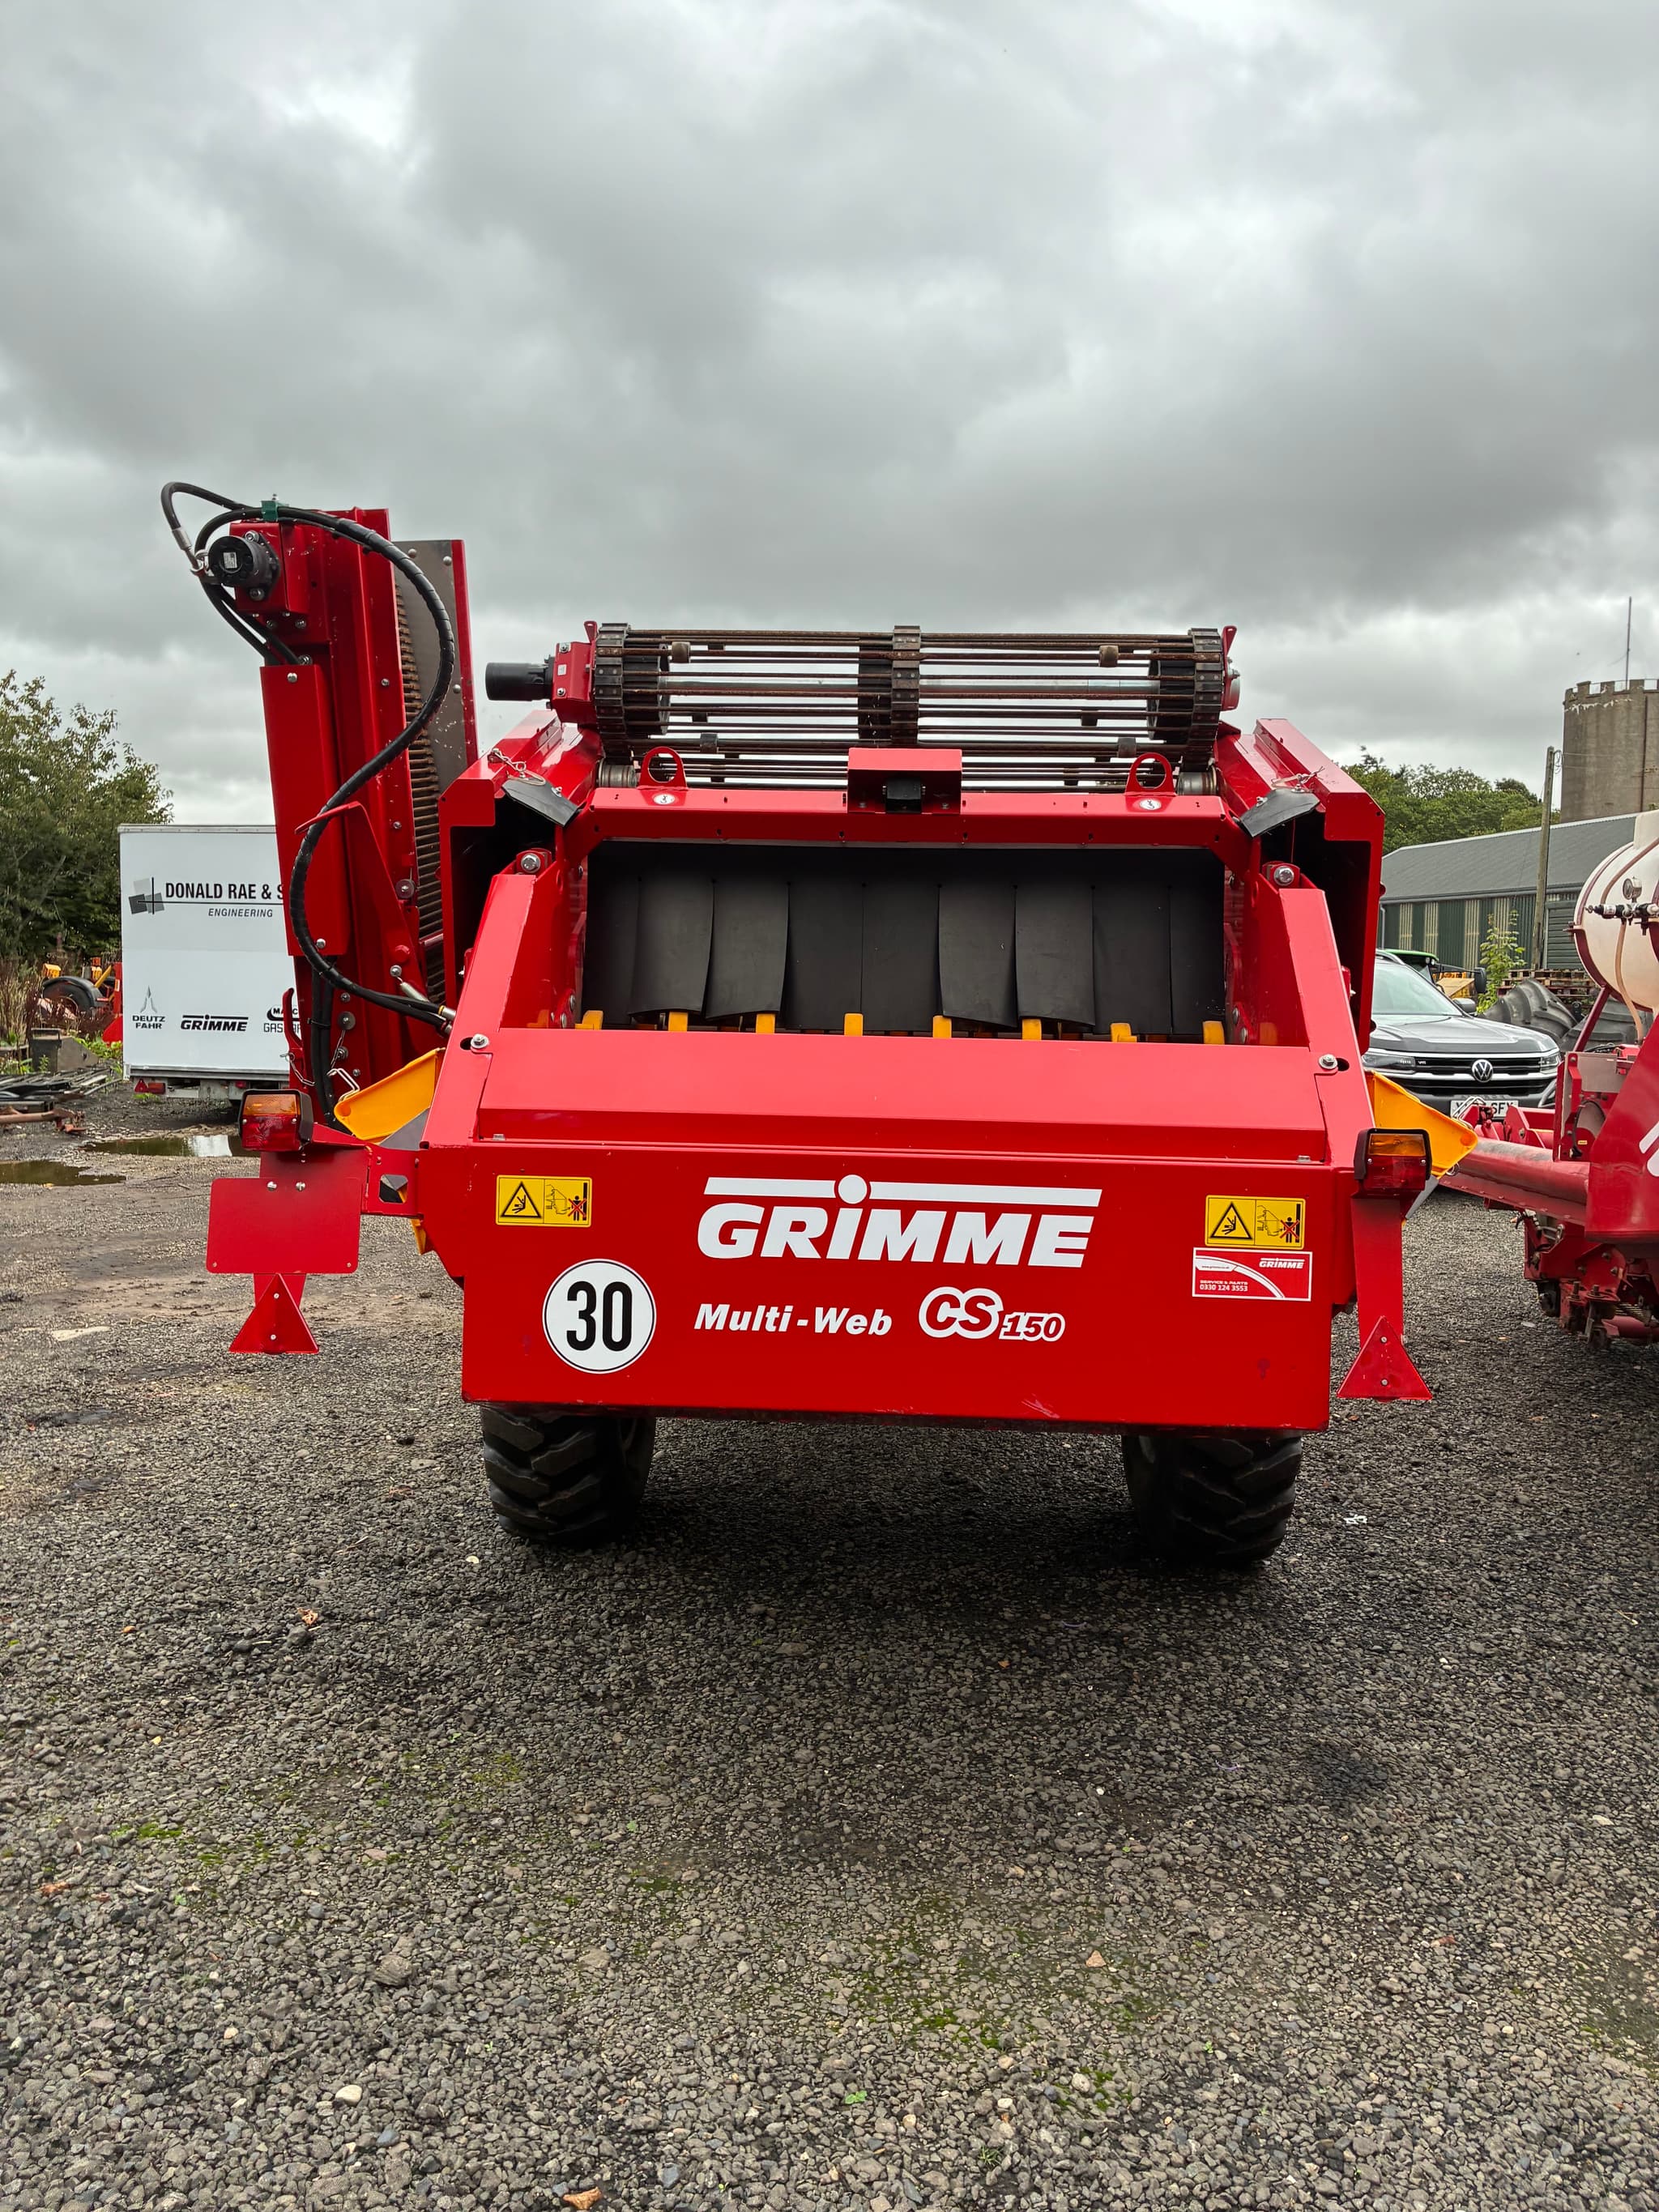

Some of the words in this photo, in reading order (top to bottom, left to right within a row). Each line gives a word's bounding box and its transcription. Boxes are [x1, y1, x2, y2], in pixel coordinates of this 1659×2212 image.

[165, 882, 223, 898] DONALD
[228, 884, 257, 899] RAE
[261, 884, 272, 900] &
[207, 908, 273, 918] ENGINEERING
[566, 1281, 632, 1352] 30
